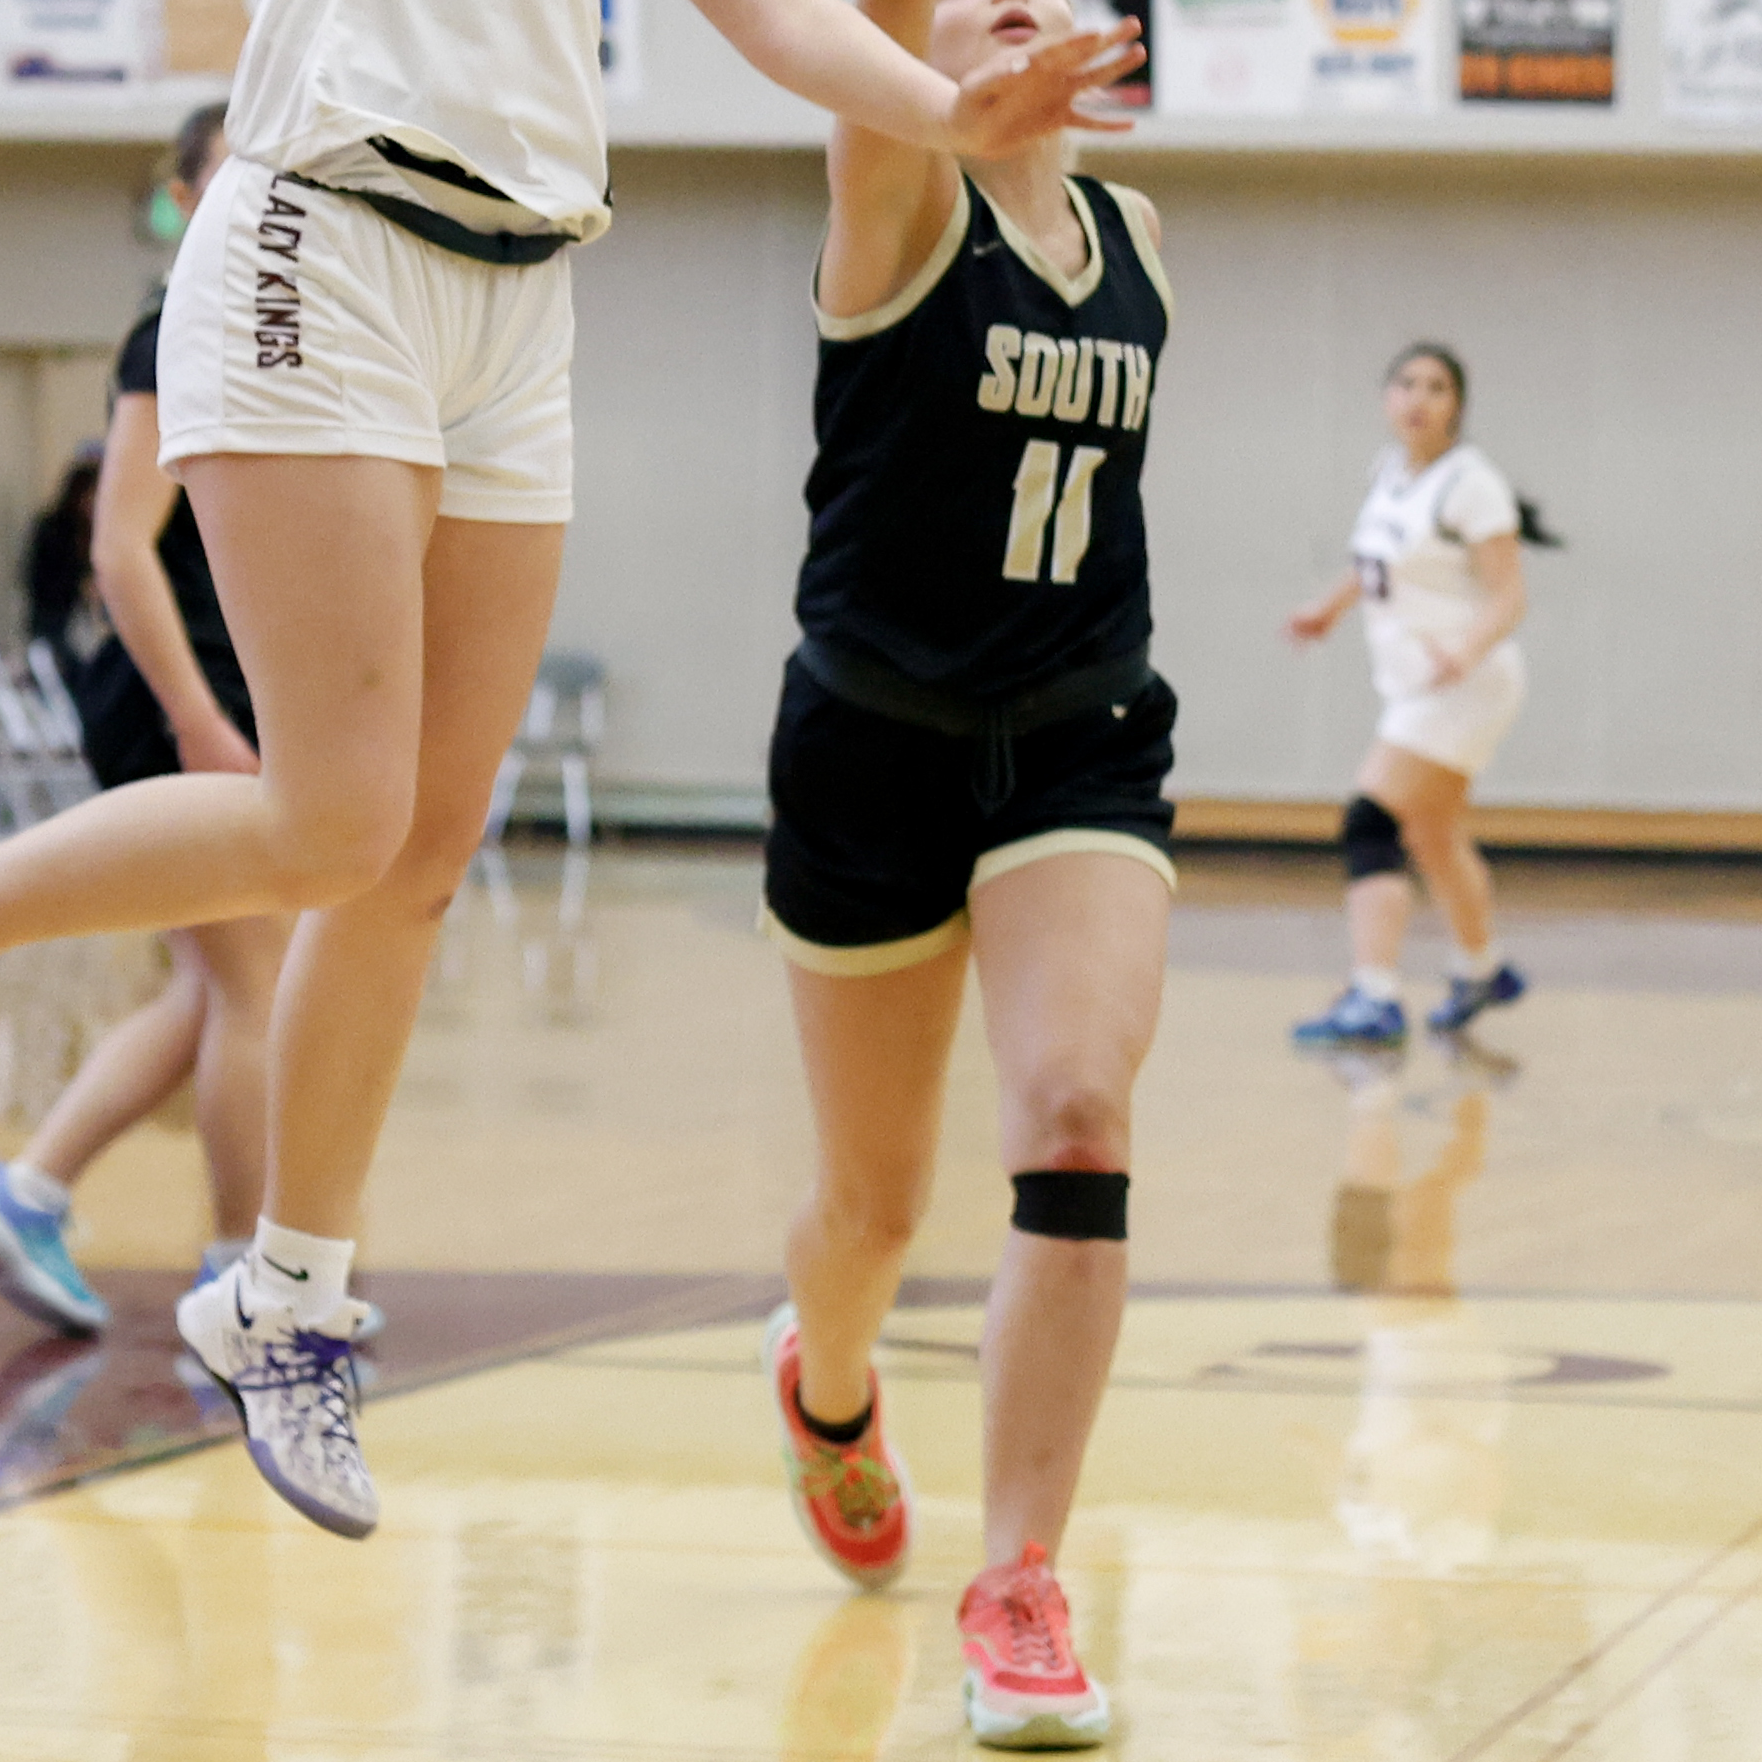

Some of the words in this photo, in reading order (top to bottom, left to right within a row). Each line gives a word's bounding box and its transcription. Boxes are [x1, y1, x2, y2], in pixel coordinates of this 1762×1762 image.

[255, 270, 303, 369] KINGS
[977, 324, 1151, 432] SOUTH
[1002, 439, 1108, 584] 11
